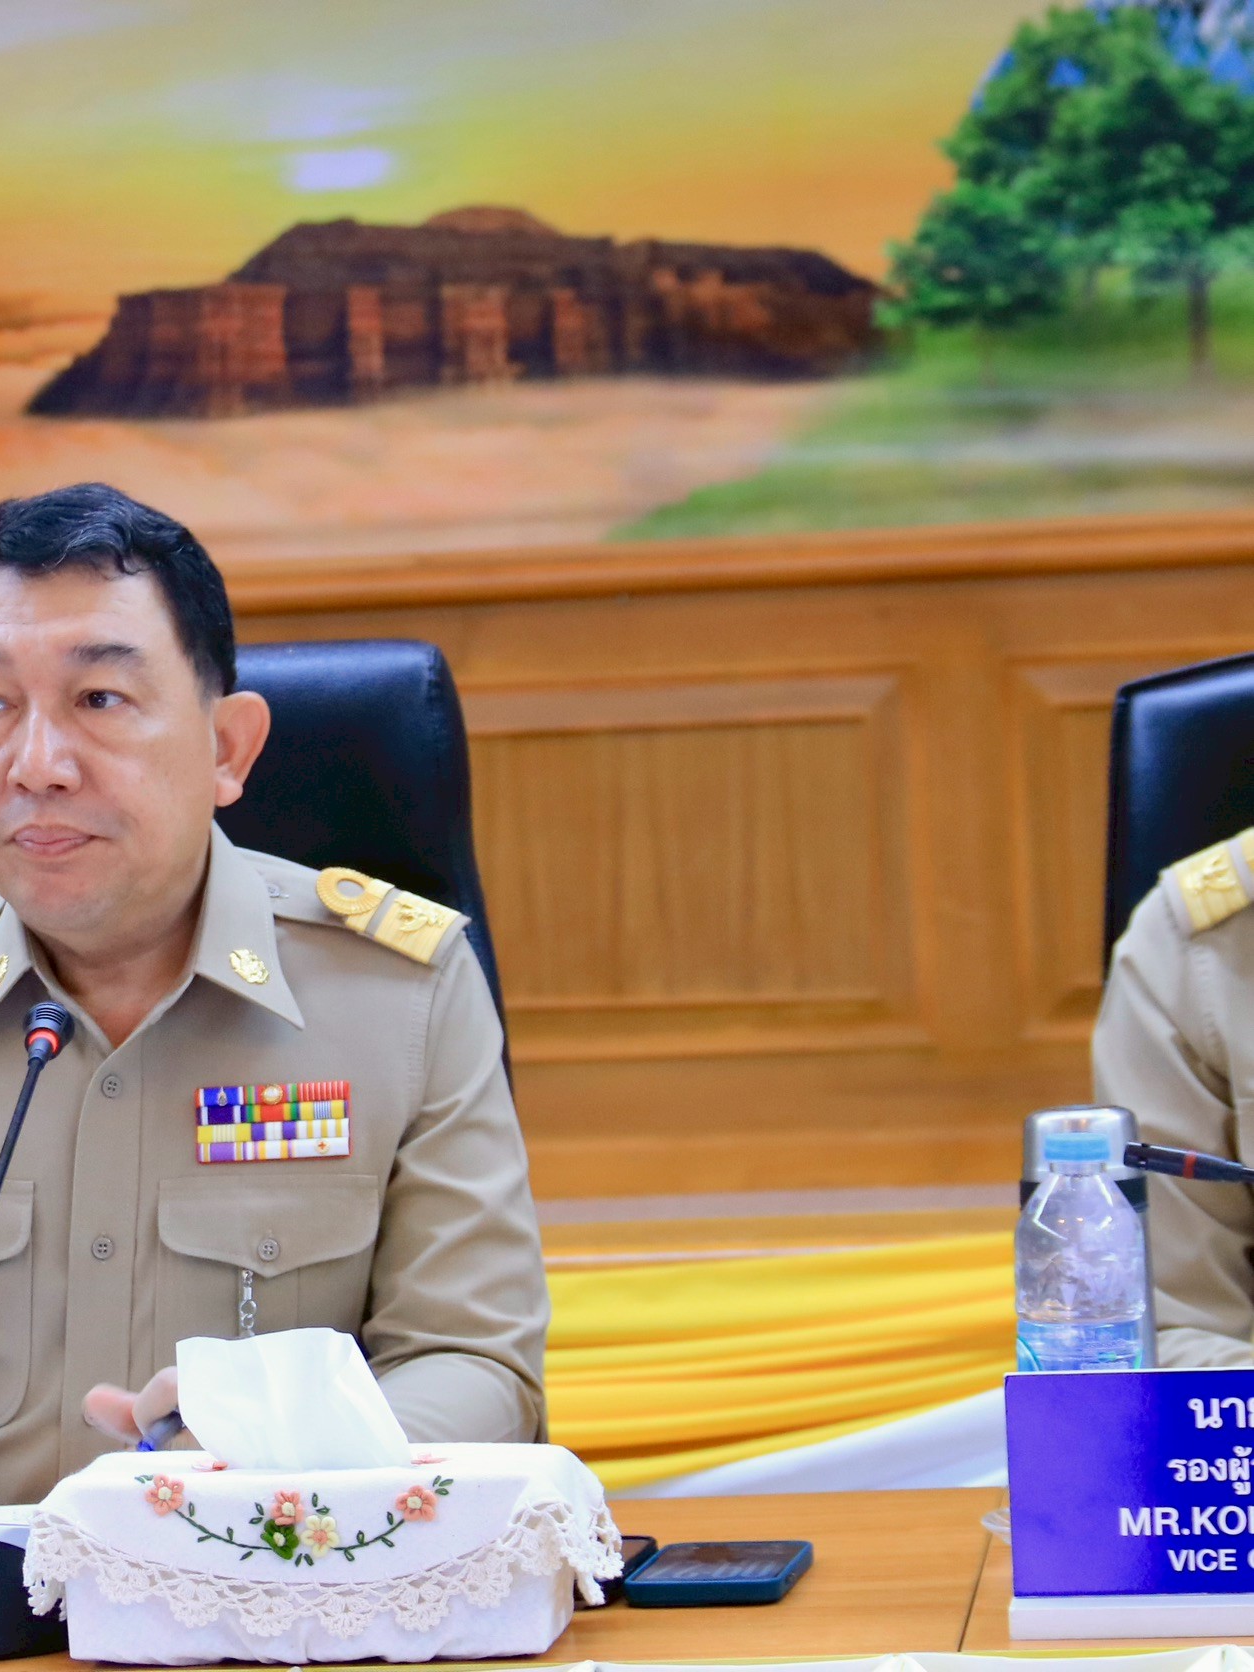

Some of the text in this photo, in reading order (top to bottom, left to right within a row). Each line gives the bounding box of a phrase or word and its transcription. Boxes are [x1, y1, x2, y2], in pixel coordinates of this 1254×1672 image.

[1166, 1445, 1254, 1495] รองผู้
[1119, 1505, 1254, 1536] MR.KO
[1167, 1548, 1238, 1572] VICE
